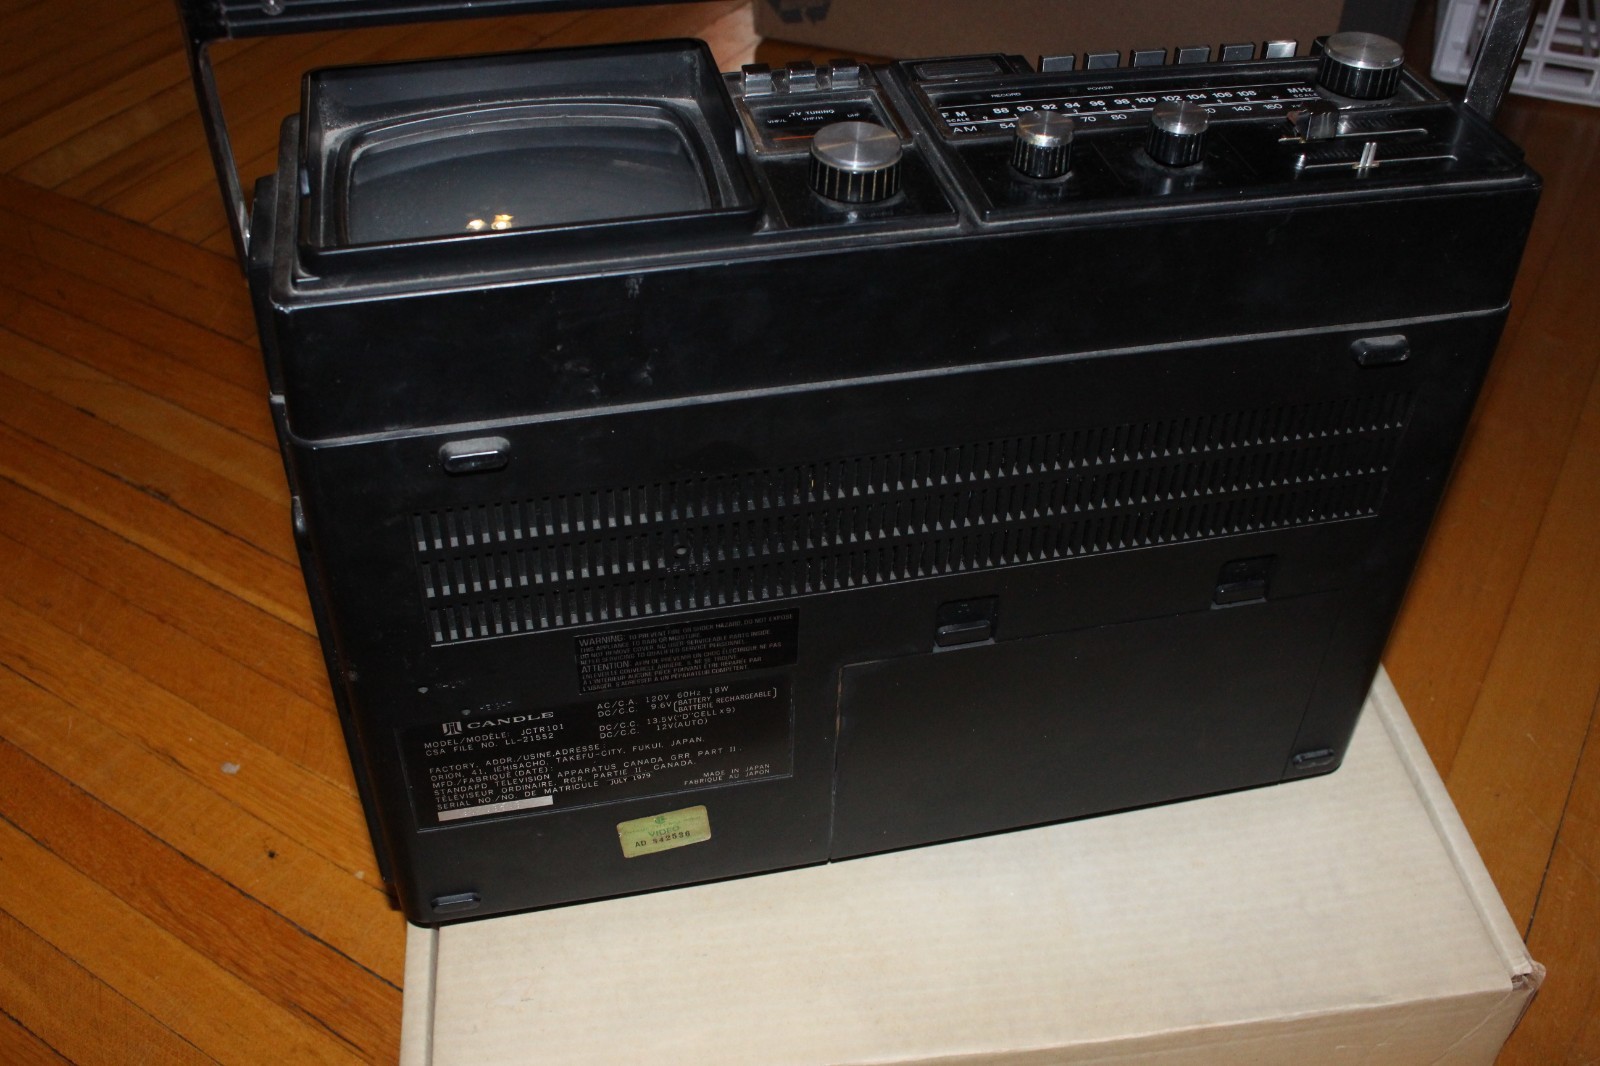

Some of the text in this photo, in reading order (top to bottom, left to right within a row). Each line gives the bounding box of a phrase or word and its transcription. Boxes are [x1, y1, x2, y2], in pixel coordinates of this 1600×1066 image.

[953, 125, 978, 133] AM
[646, 694, 670, 703] 120V
[677, 690, 701, 699] 60Hz
[709, 685, 729, 694] 18W
[716, 690, 771, 704] RECHARGEABLE
[466, 711, 555, 729] CANDLE
[521, 723, 564, 736] JCTR101
[425, 733, 554, 757] CSA FILE NO. LL-21552
[434, 783, 488, 796] STANDARD
[495, 774, 550, 787] TELEVISION
[557, 763, 617, 778] APPARATUS
[623, 756, 664, 768] CANADA
[697, 747, 723, 757] PART
[593, 768, 628, 779] PARTIE
[703, 769, 726, 778] MADE
[745, 763, 770, 772] JAPAN
[745, 769, 770, 778] JAPON
[437, 800, 471, 811] SERIAL
[524, 790, 537, 798] DE
[544, 781, 599, 795] MATRICULE
[610, 778, 628, 786] JULY
[633, 772, 651, 781] 1979
[635, 840, 647, 848] AD
